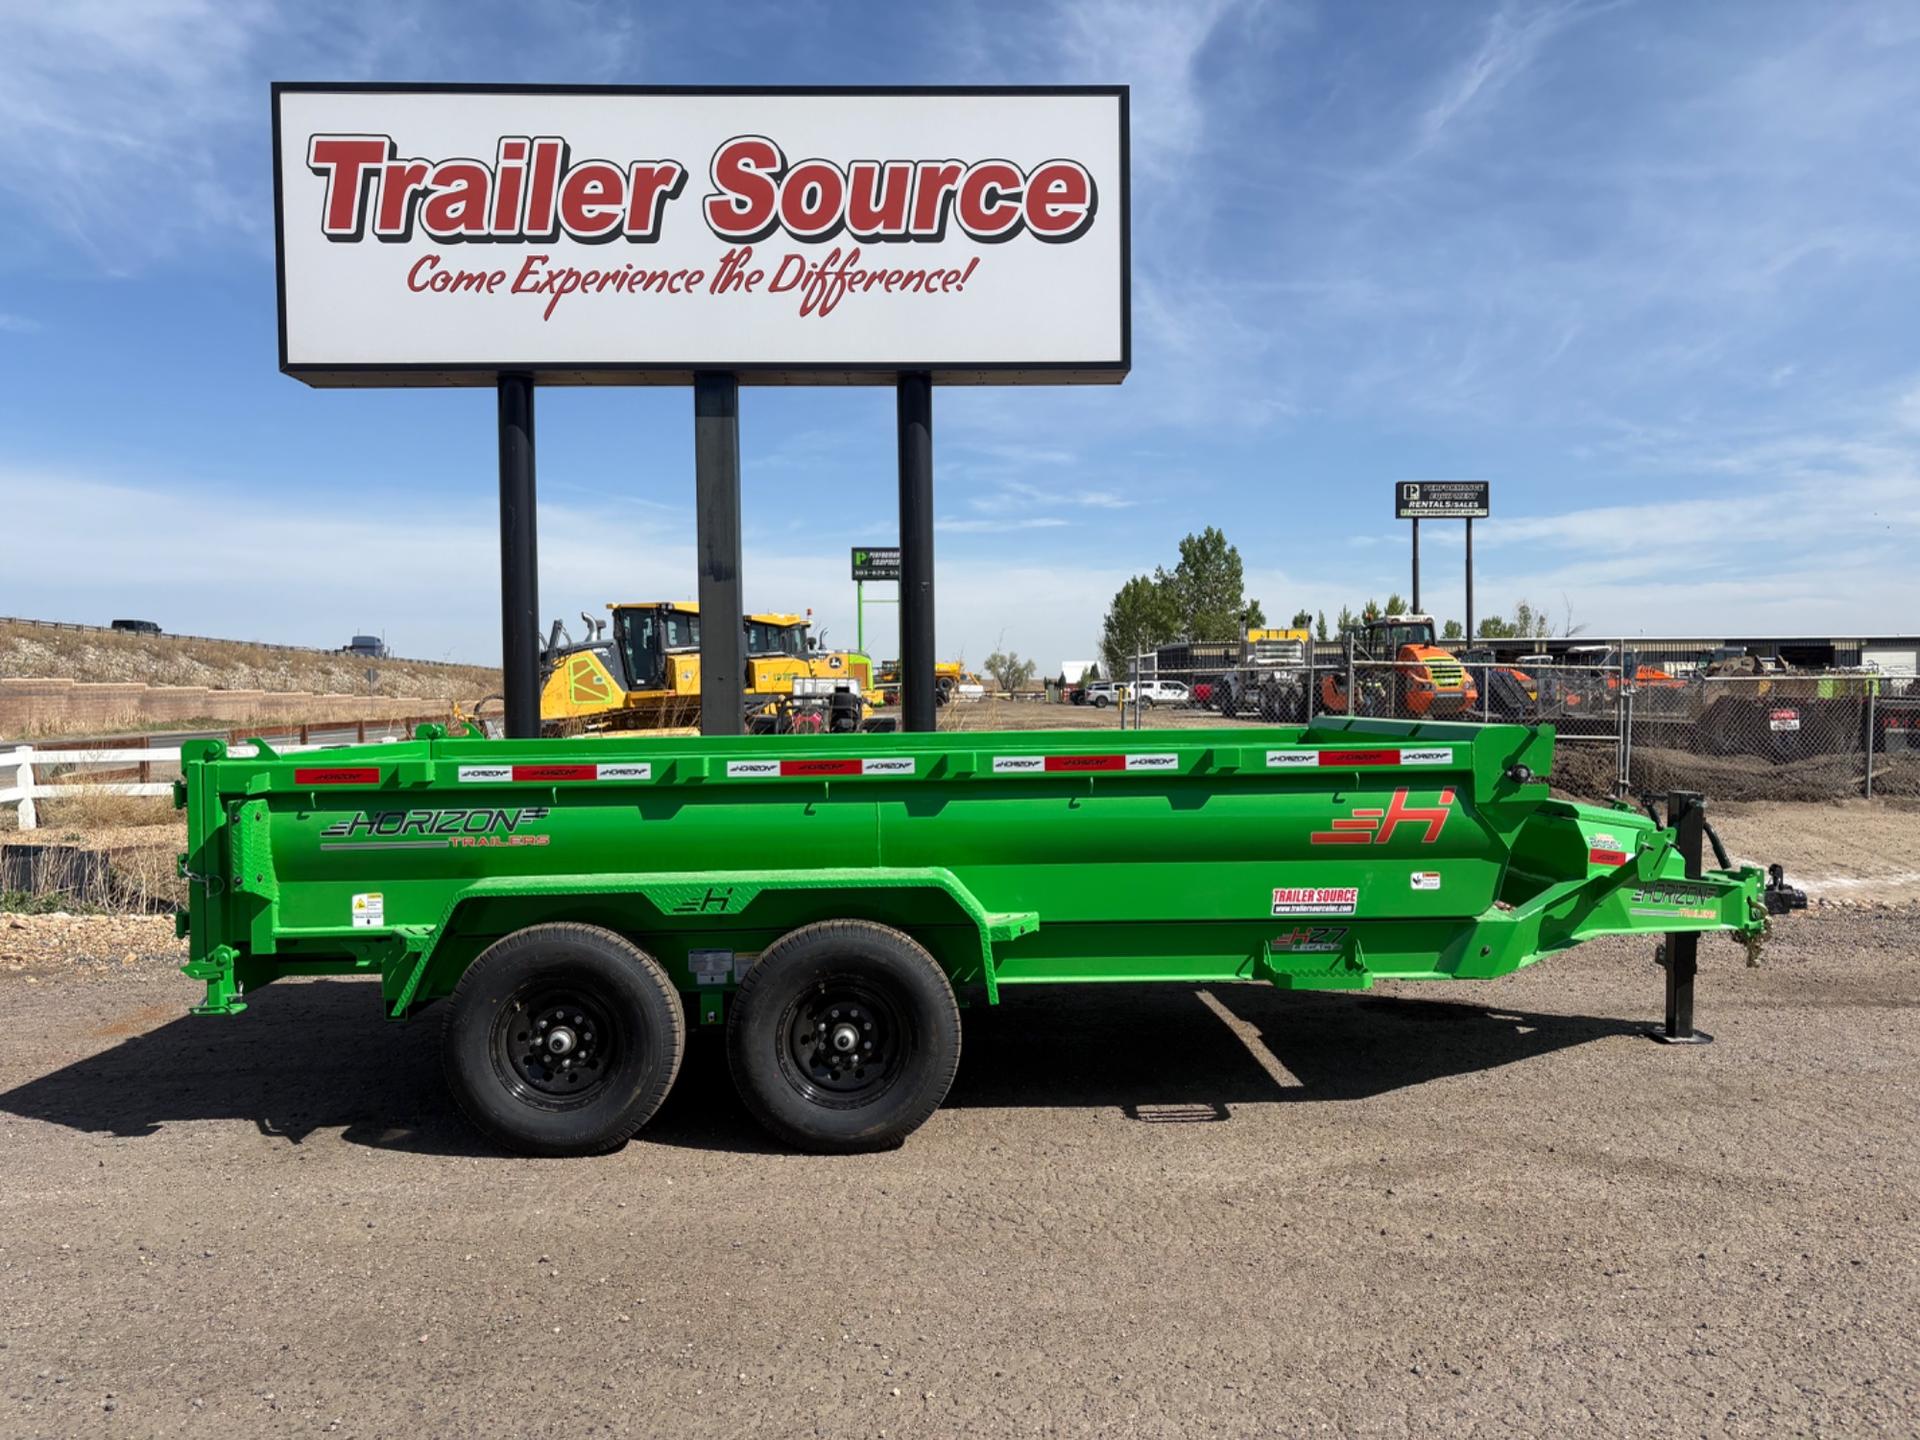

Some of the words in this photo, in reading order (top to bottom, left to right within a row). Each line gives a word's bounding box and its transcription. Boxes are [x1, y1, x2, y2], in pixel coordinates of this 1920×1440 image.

[307, 134, 689, 244] Trailer
[703, 134, 1098, 244] Source
[407, 254, 506, 293] Come
[511, 255, 704, 322] Experience
[709, 246, 764, 295] the
[768, 247, 980, 318] Difference!
[1408, 752, 1448, 760] HORIZON
[604, 768, 645, 776] HORIZON
[870, 762, 910, 770] HORIZON
[466, 769, 507, 777] HORIZON
[346, 808, 525, 836] HORIZON
[449, 835, 550, 848] TRAILERS
[1274, 889, 1315, 902] TRAILER
[1316, 889, 1357, 902] SOURCE
[1642, 883, 1708, 906] HORIZON
